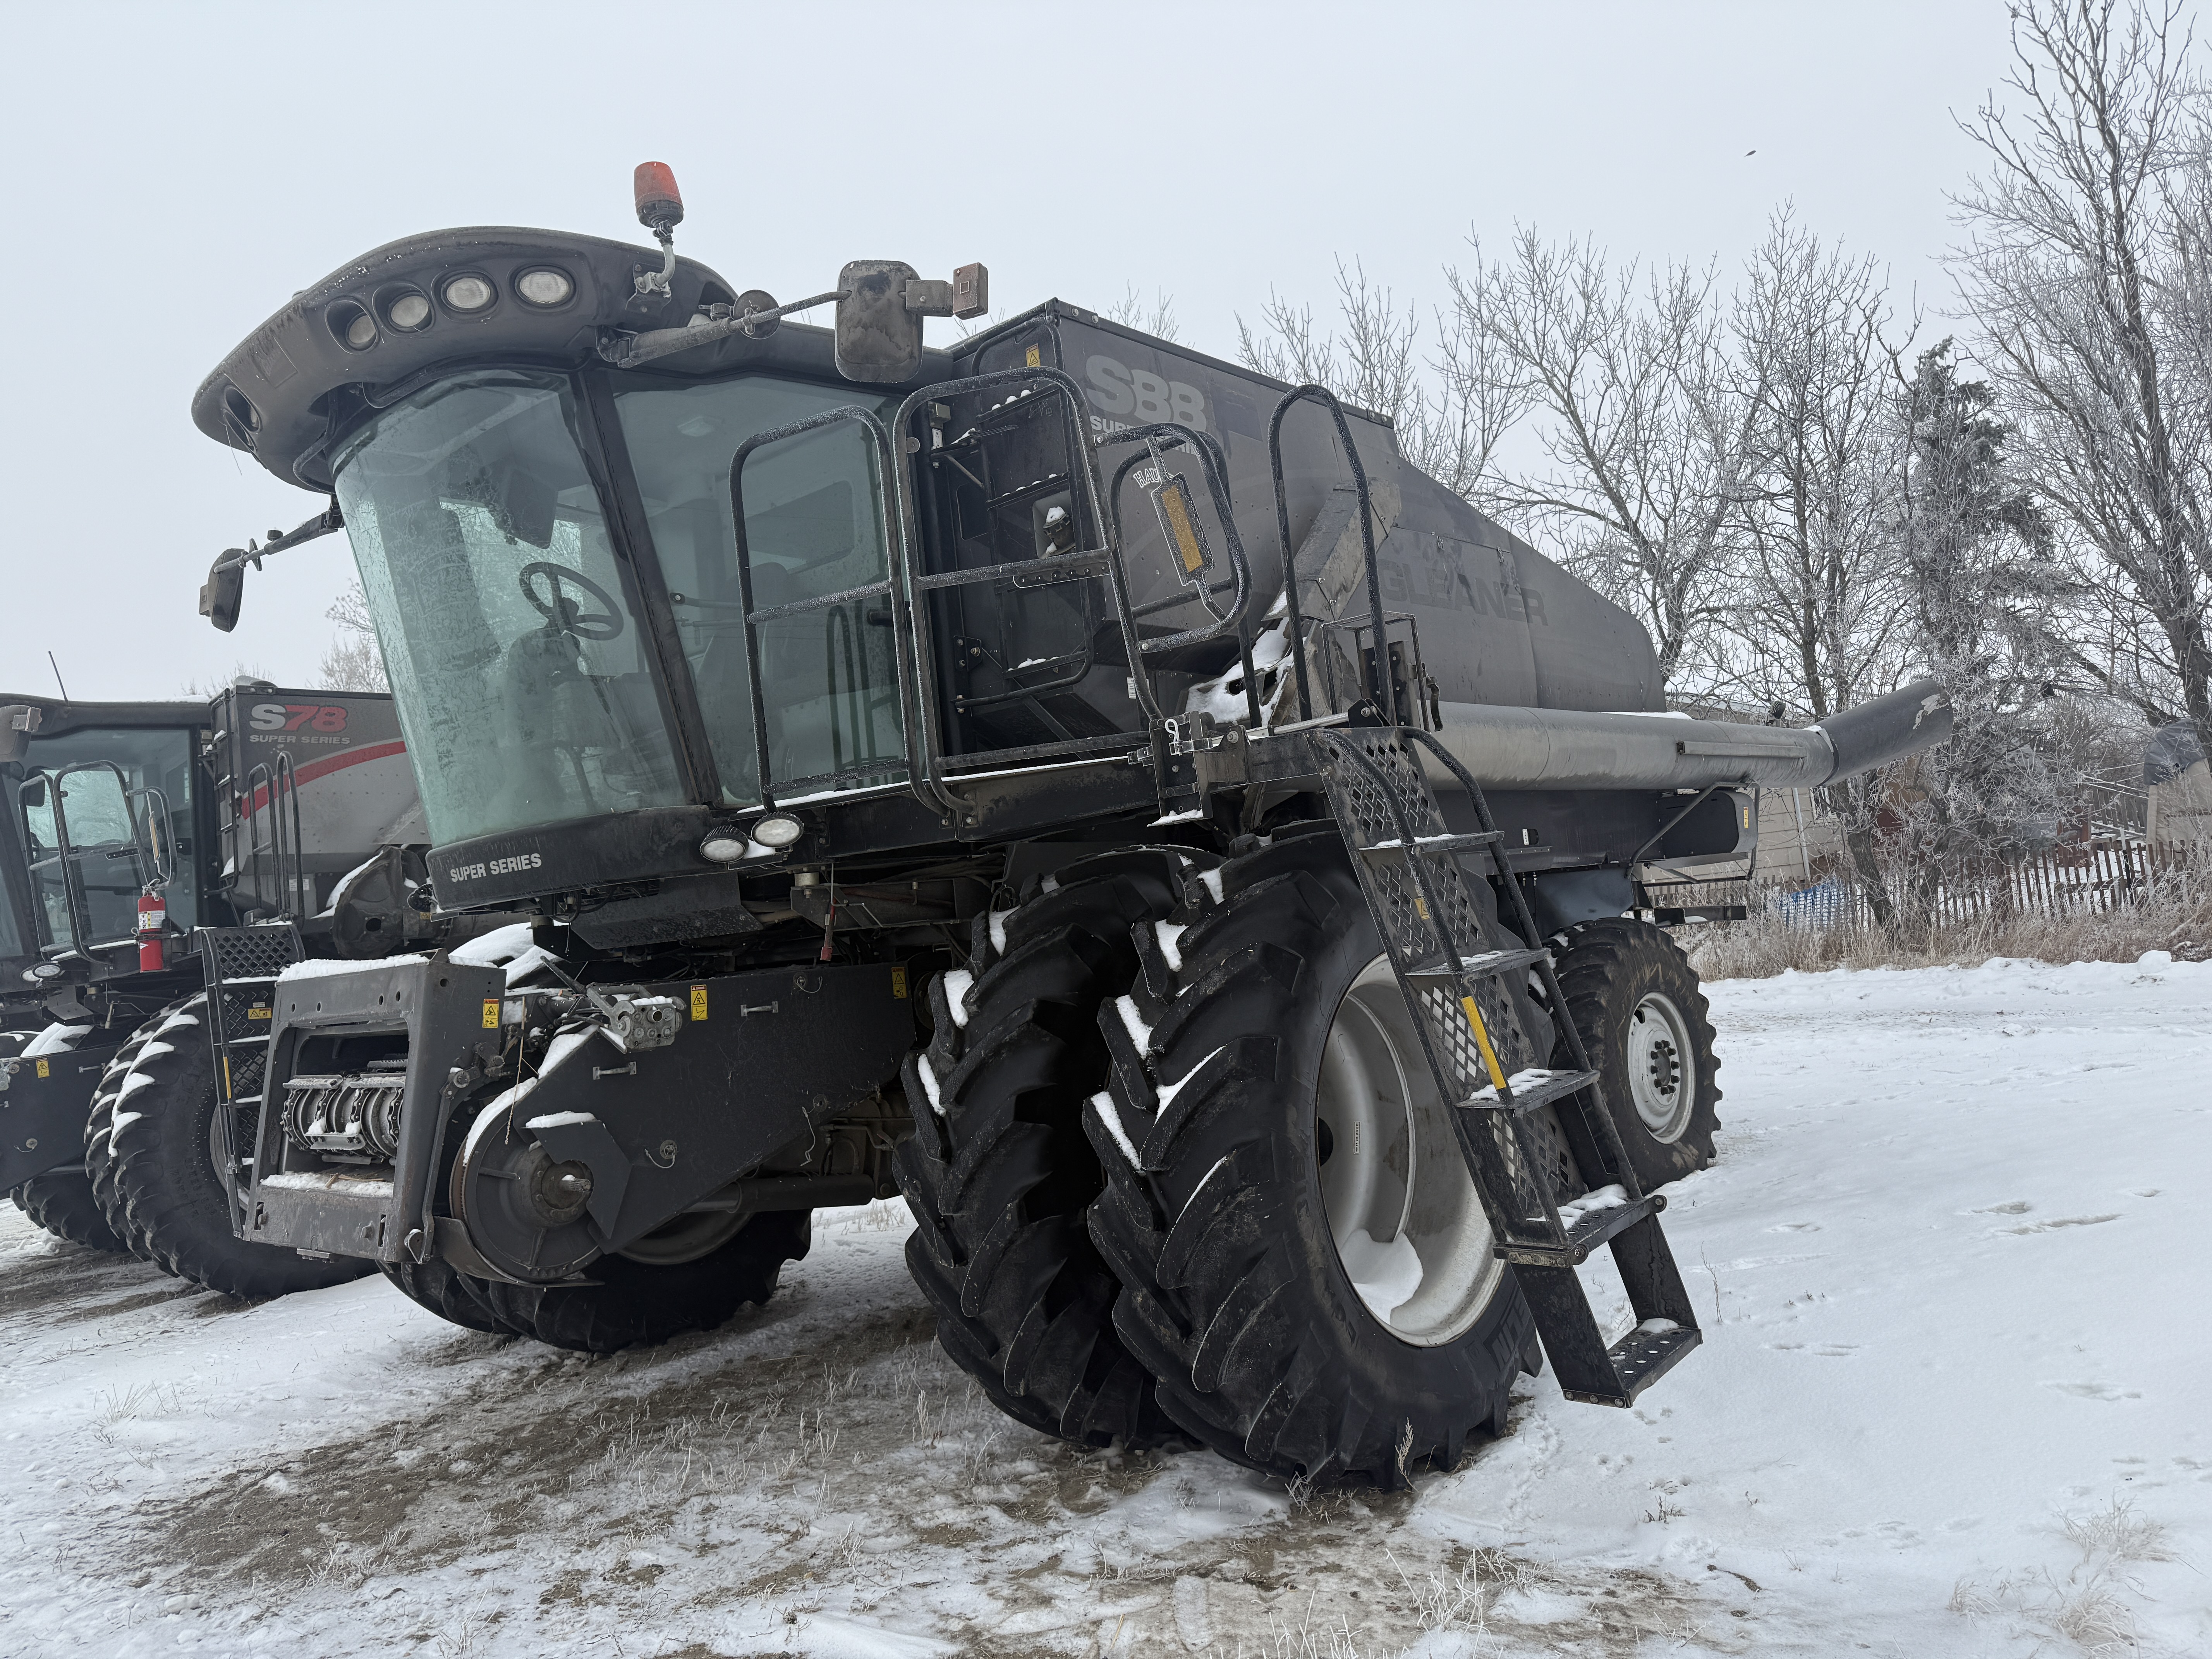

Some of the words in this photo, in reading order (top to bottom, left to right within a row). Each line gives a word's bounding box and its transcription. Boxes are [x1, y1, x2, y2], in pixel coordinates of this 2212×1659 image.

[1086, 355, 1207, 432] S88
[1090, 415, 1135, 433] SUP
[1133, 468, 1160, 488] HAU
[1377, 558, 1549, 626] GLEANER
[249, 704, 347, 732] S78
[250, 735, 296, 743] SUPER
[301, 736, 351, 744] SERIES
[450, 863, 487, 882] SUPER
[489, 853, 542, 875] SERIES
